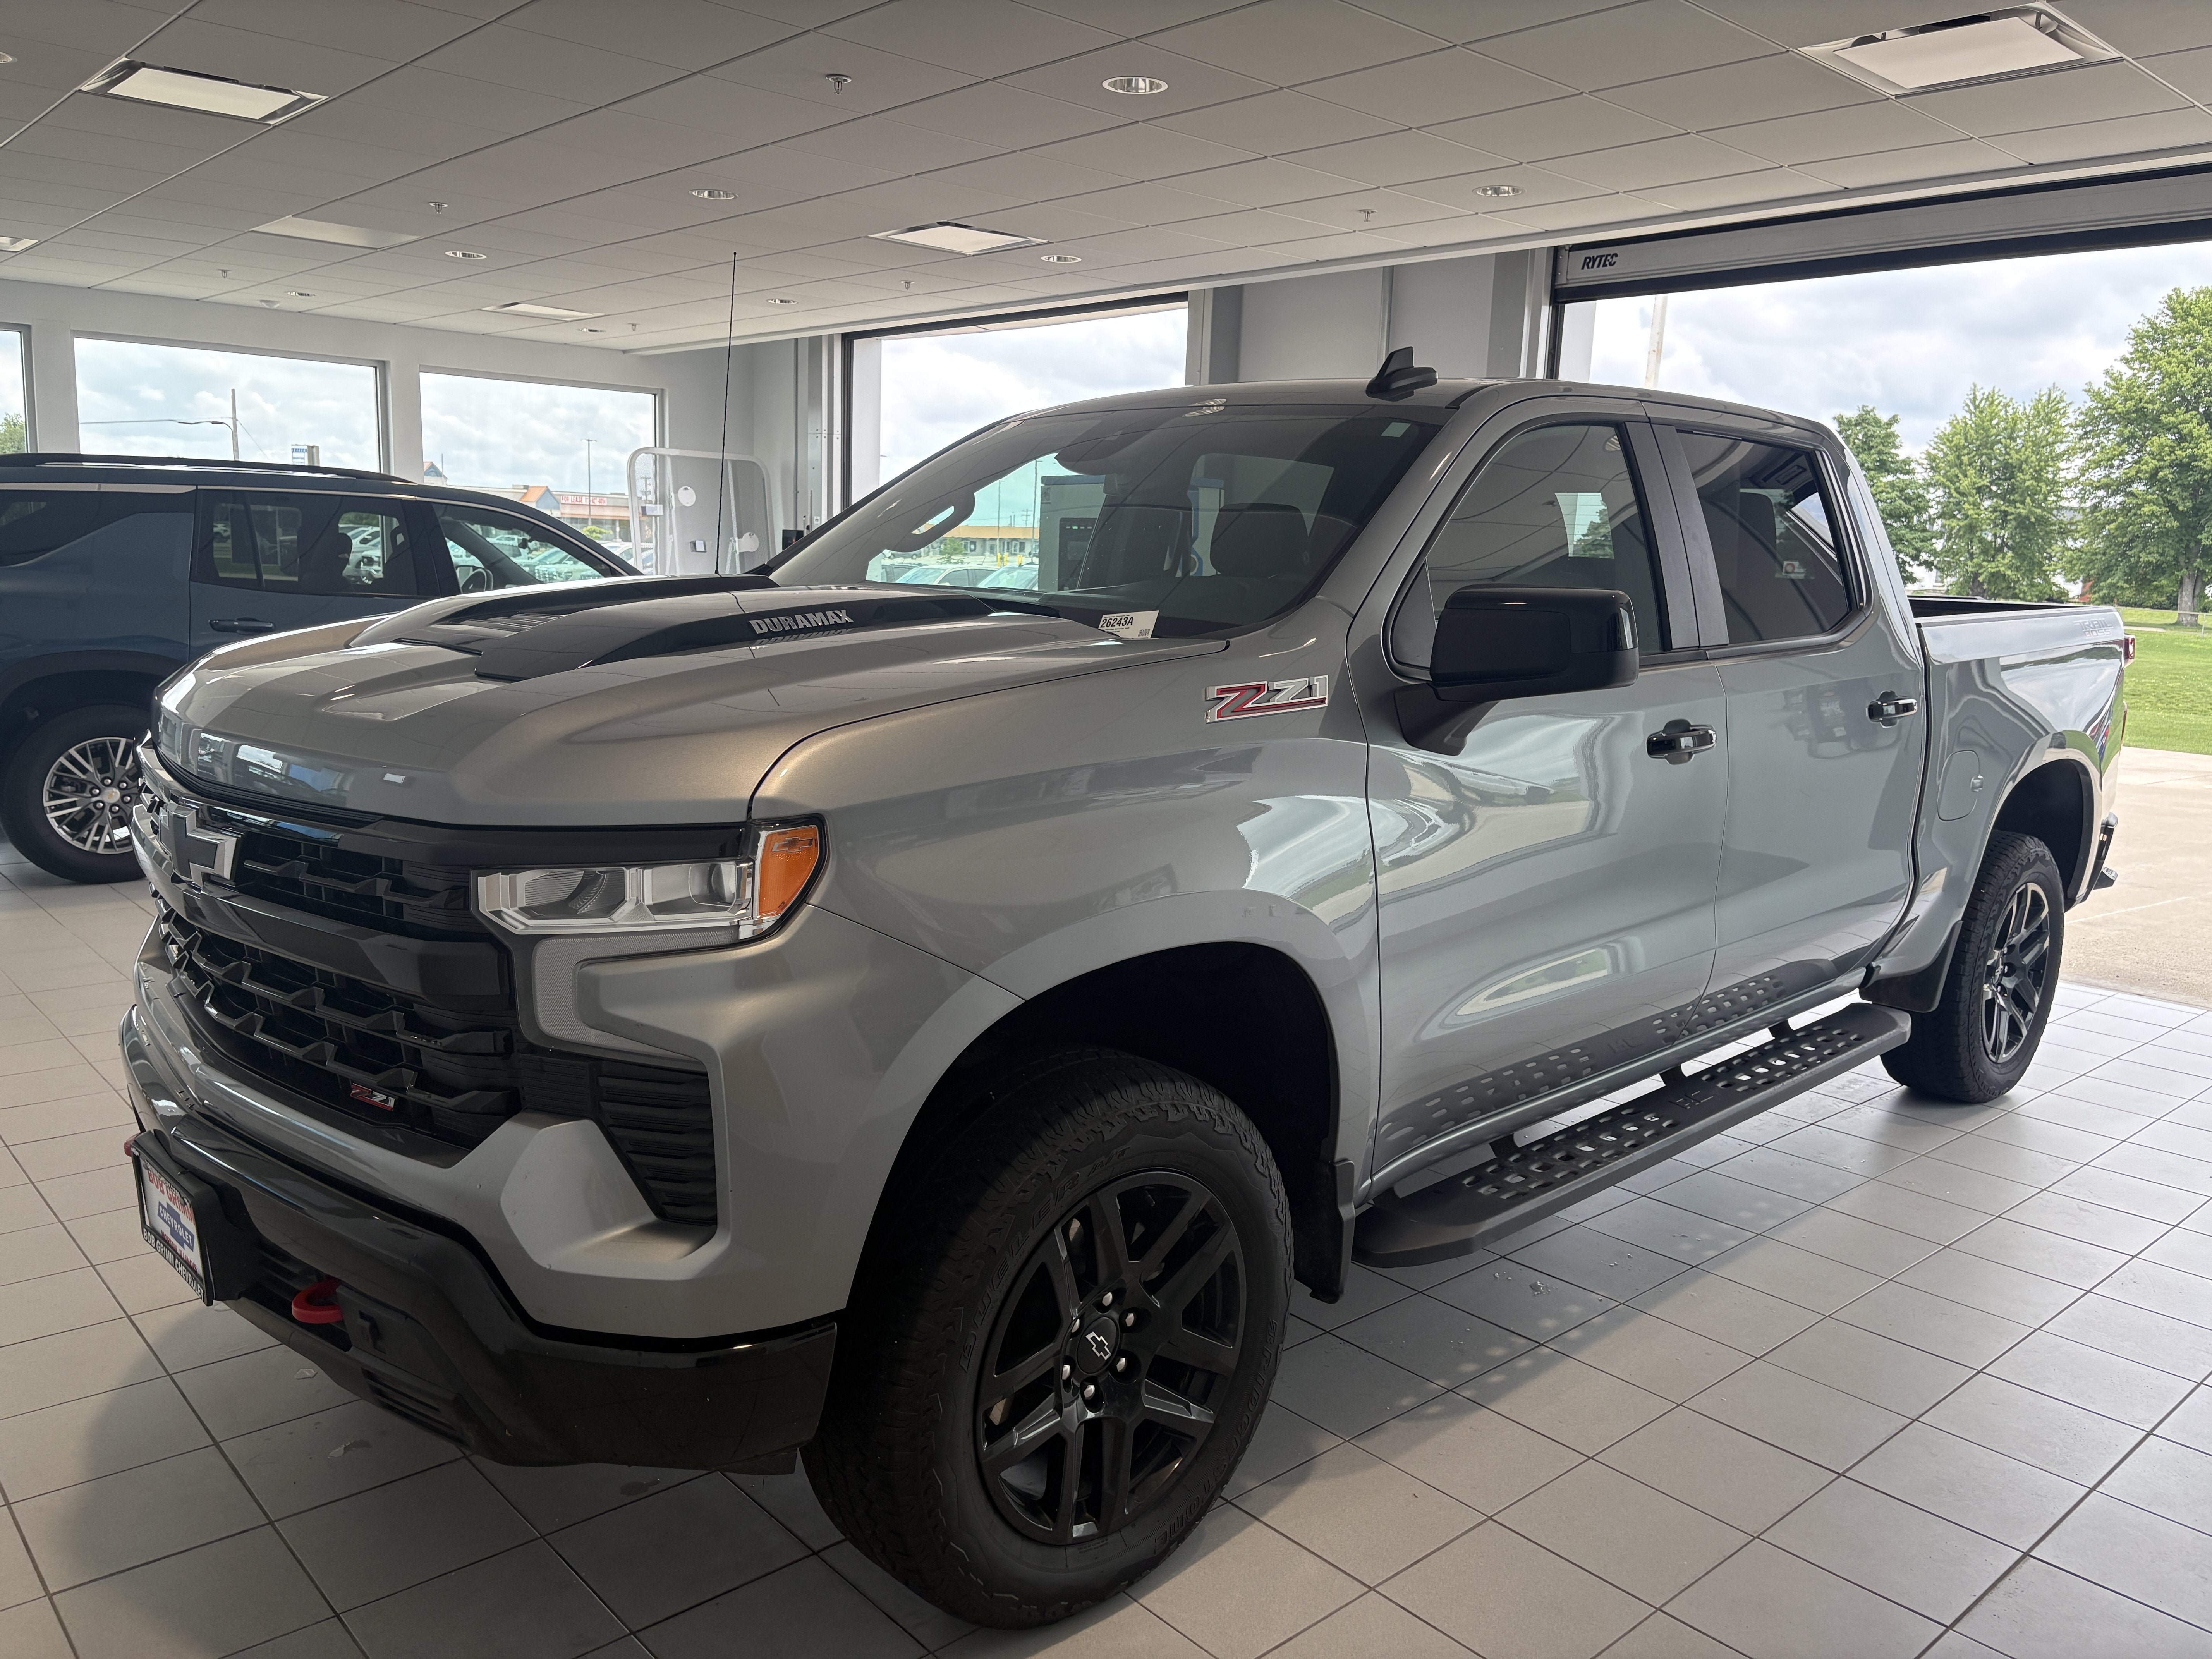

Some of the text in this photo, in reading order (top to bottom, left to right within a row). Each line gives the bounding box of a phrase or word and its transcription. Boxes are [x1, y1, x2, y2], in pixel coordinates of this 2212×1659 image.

[1581, 252, 1618, 270] RYTEC
[749, 609, 854, 634] DURAMAX
[1100, 616, 1133, 628] 26243A
[2073, 618, 2114, 631] TRAIL
[2083, 628, 2112, 639] BOSS
[1205, 675, 1328, 724] Z71
[350, 1083, 397, 1111] Z71
[148, 1168, 165, 1195] BOB
[159, 1205, 192, 1246] CHEVROLET
[143, 1228, 204, 1301] BOB GRIMM CHEVROLET
[959, 1145, 1131, 1372] DUELER A/T
[1154, 1317, 1278, 1555] BRIDGESTONE
